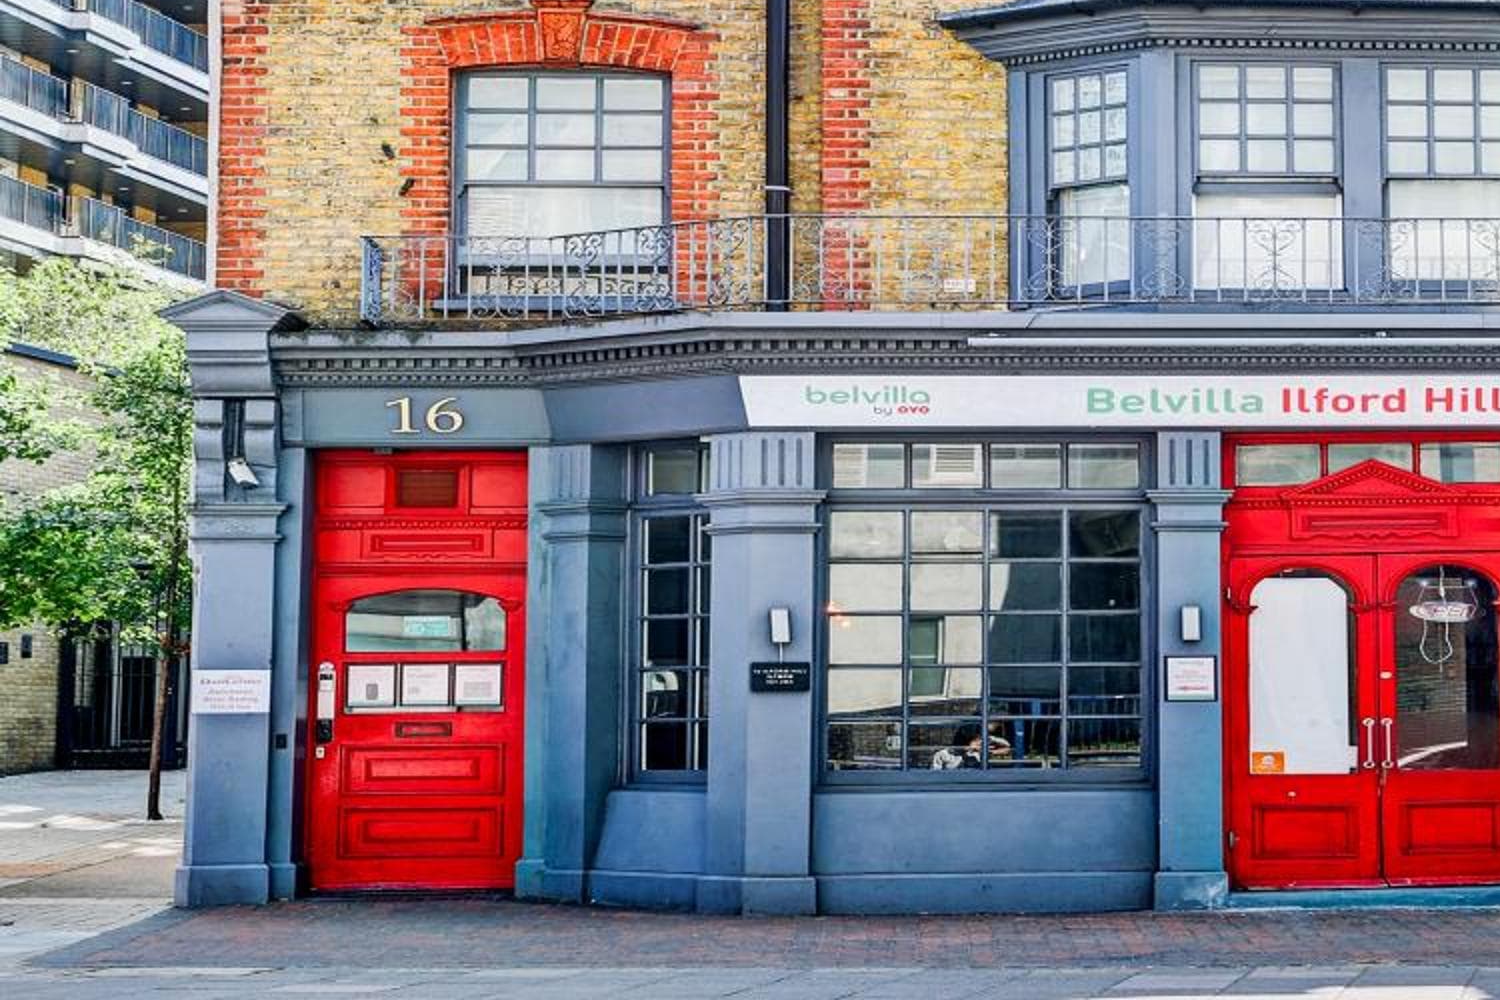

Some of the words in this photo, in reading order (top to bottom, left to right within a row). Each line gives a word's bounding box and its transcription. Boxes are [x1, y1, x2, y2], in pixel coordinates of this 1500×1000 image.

[805, 385, 930, 404] belvilla
[1086, 388, 1264, 414] Belvilla
[1282, 387, 1406, 414] Ilford
[385, 396, 464, 434] 16
[873, 405, 893, 416] by
